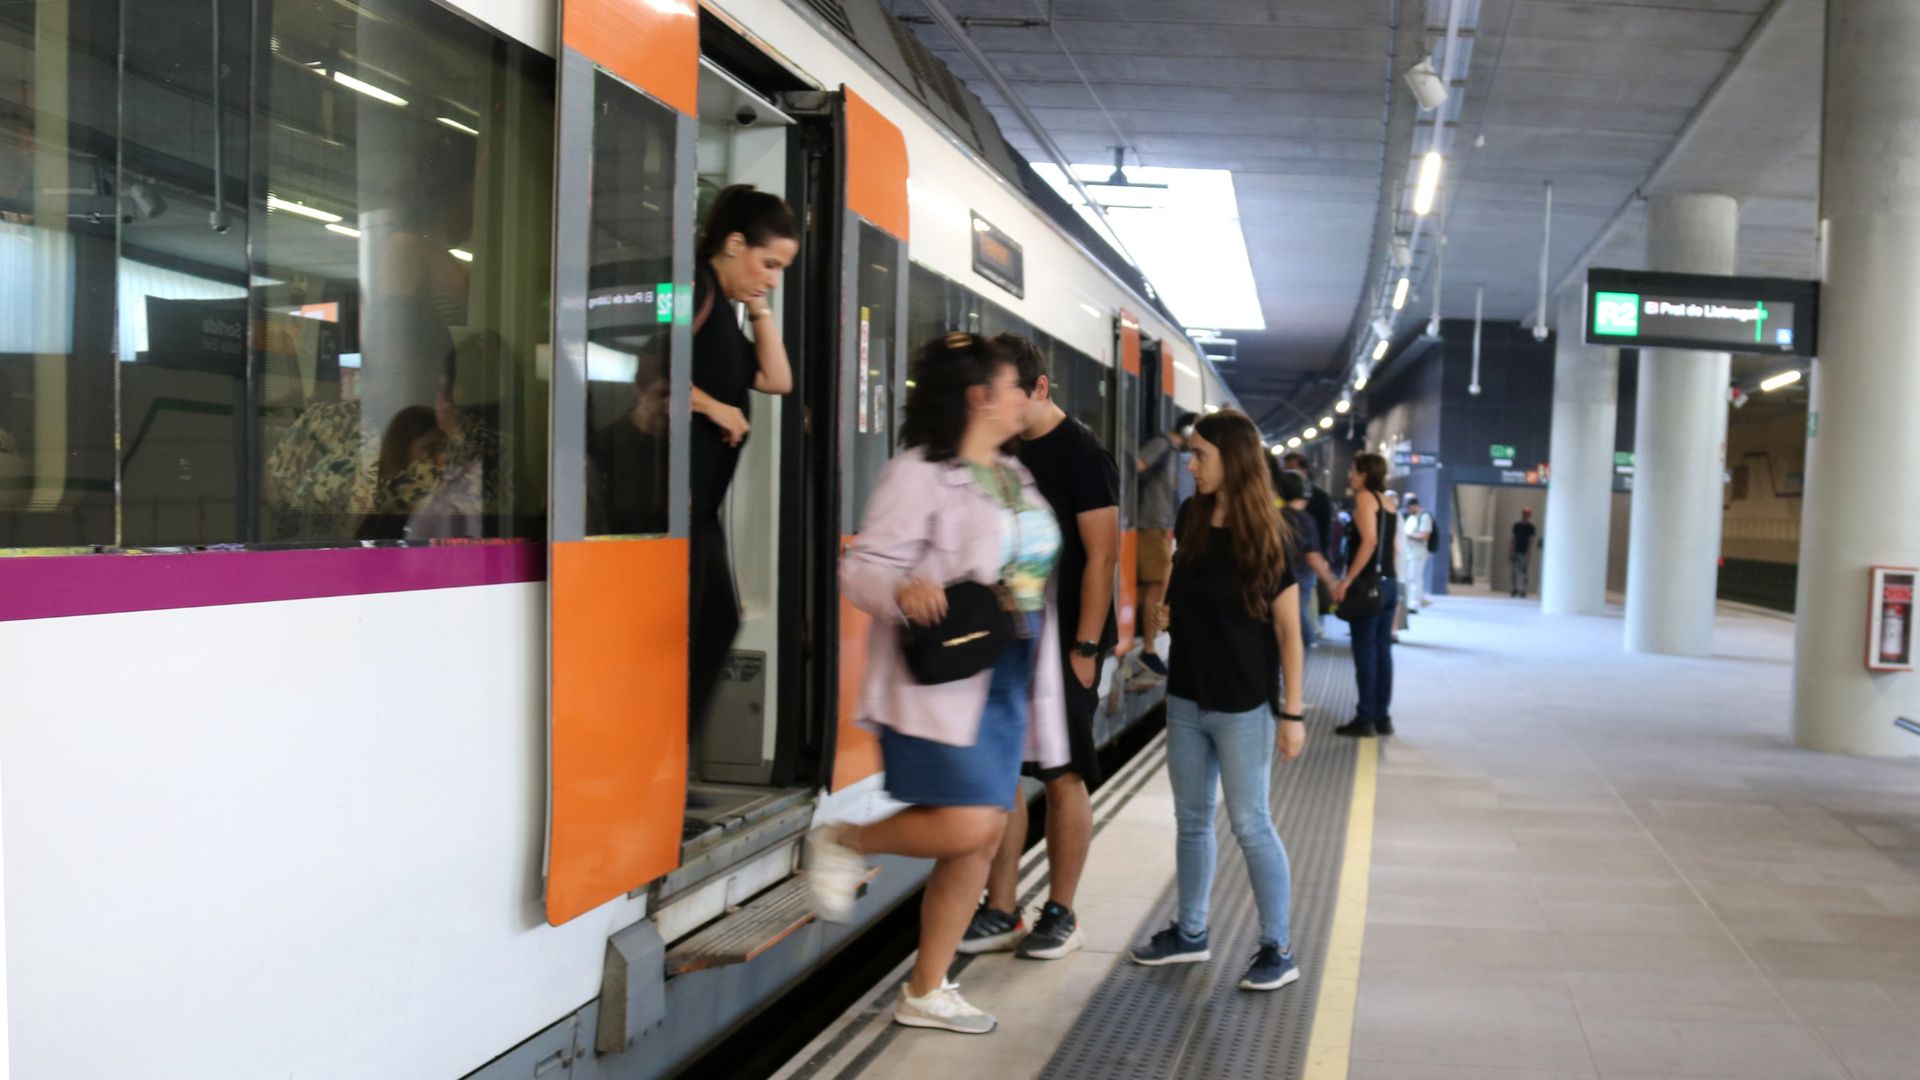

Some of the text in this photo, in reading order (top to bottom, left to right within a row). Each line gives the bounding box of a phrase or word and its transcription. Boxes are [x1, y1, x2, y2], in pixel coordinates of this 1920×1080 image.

[1599, 301, 1636, 326] R2
[1660, 301, 1686, 316] Prat
[1686, 304, 1703, 317] de
